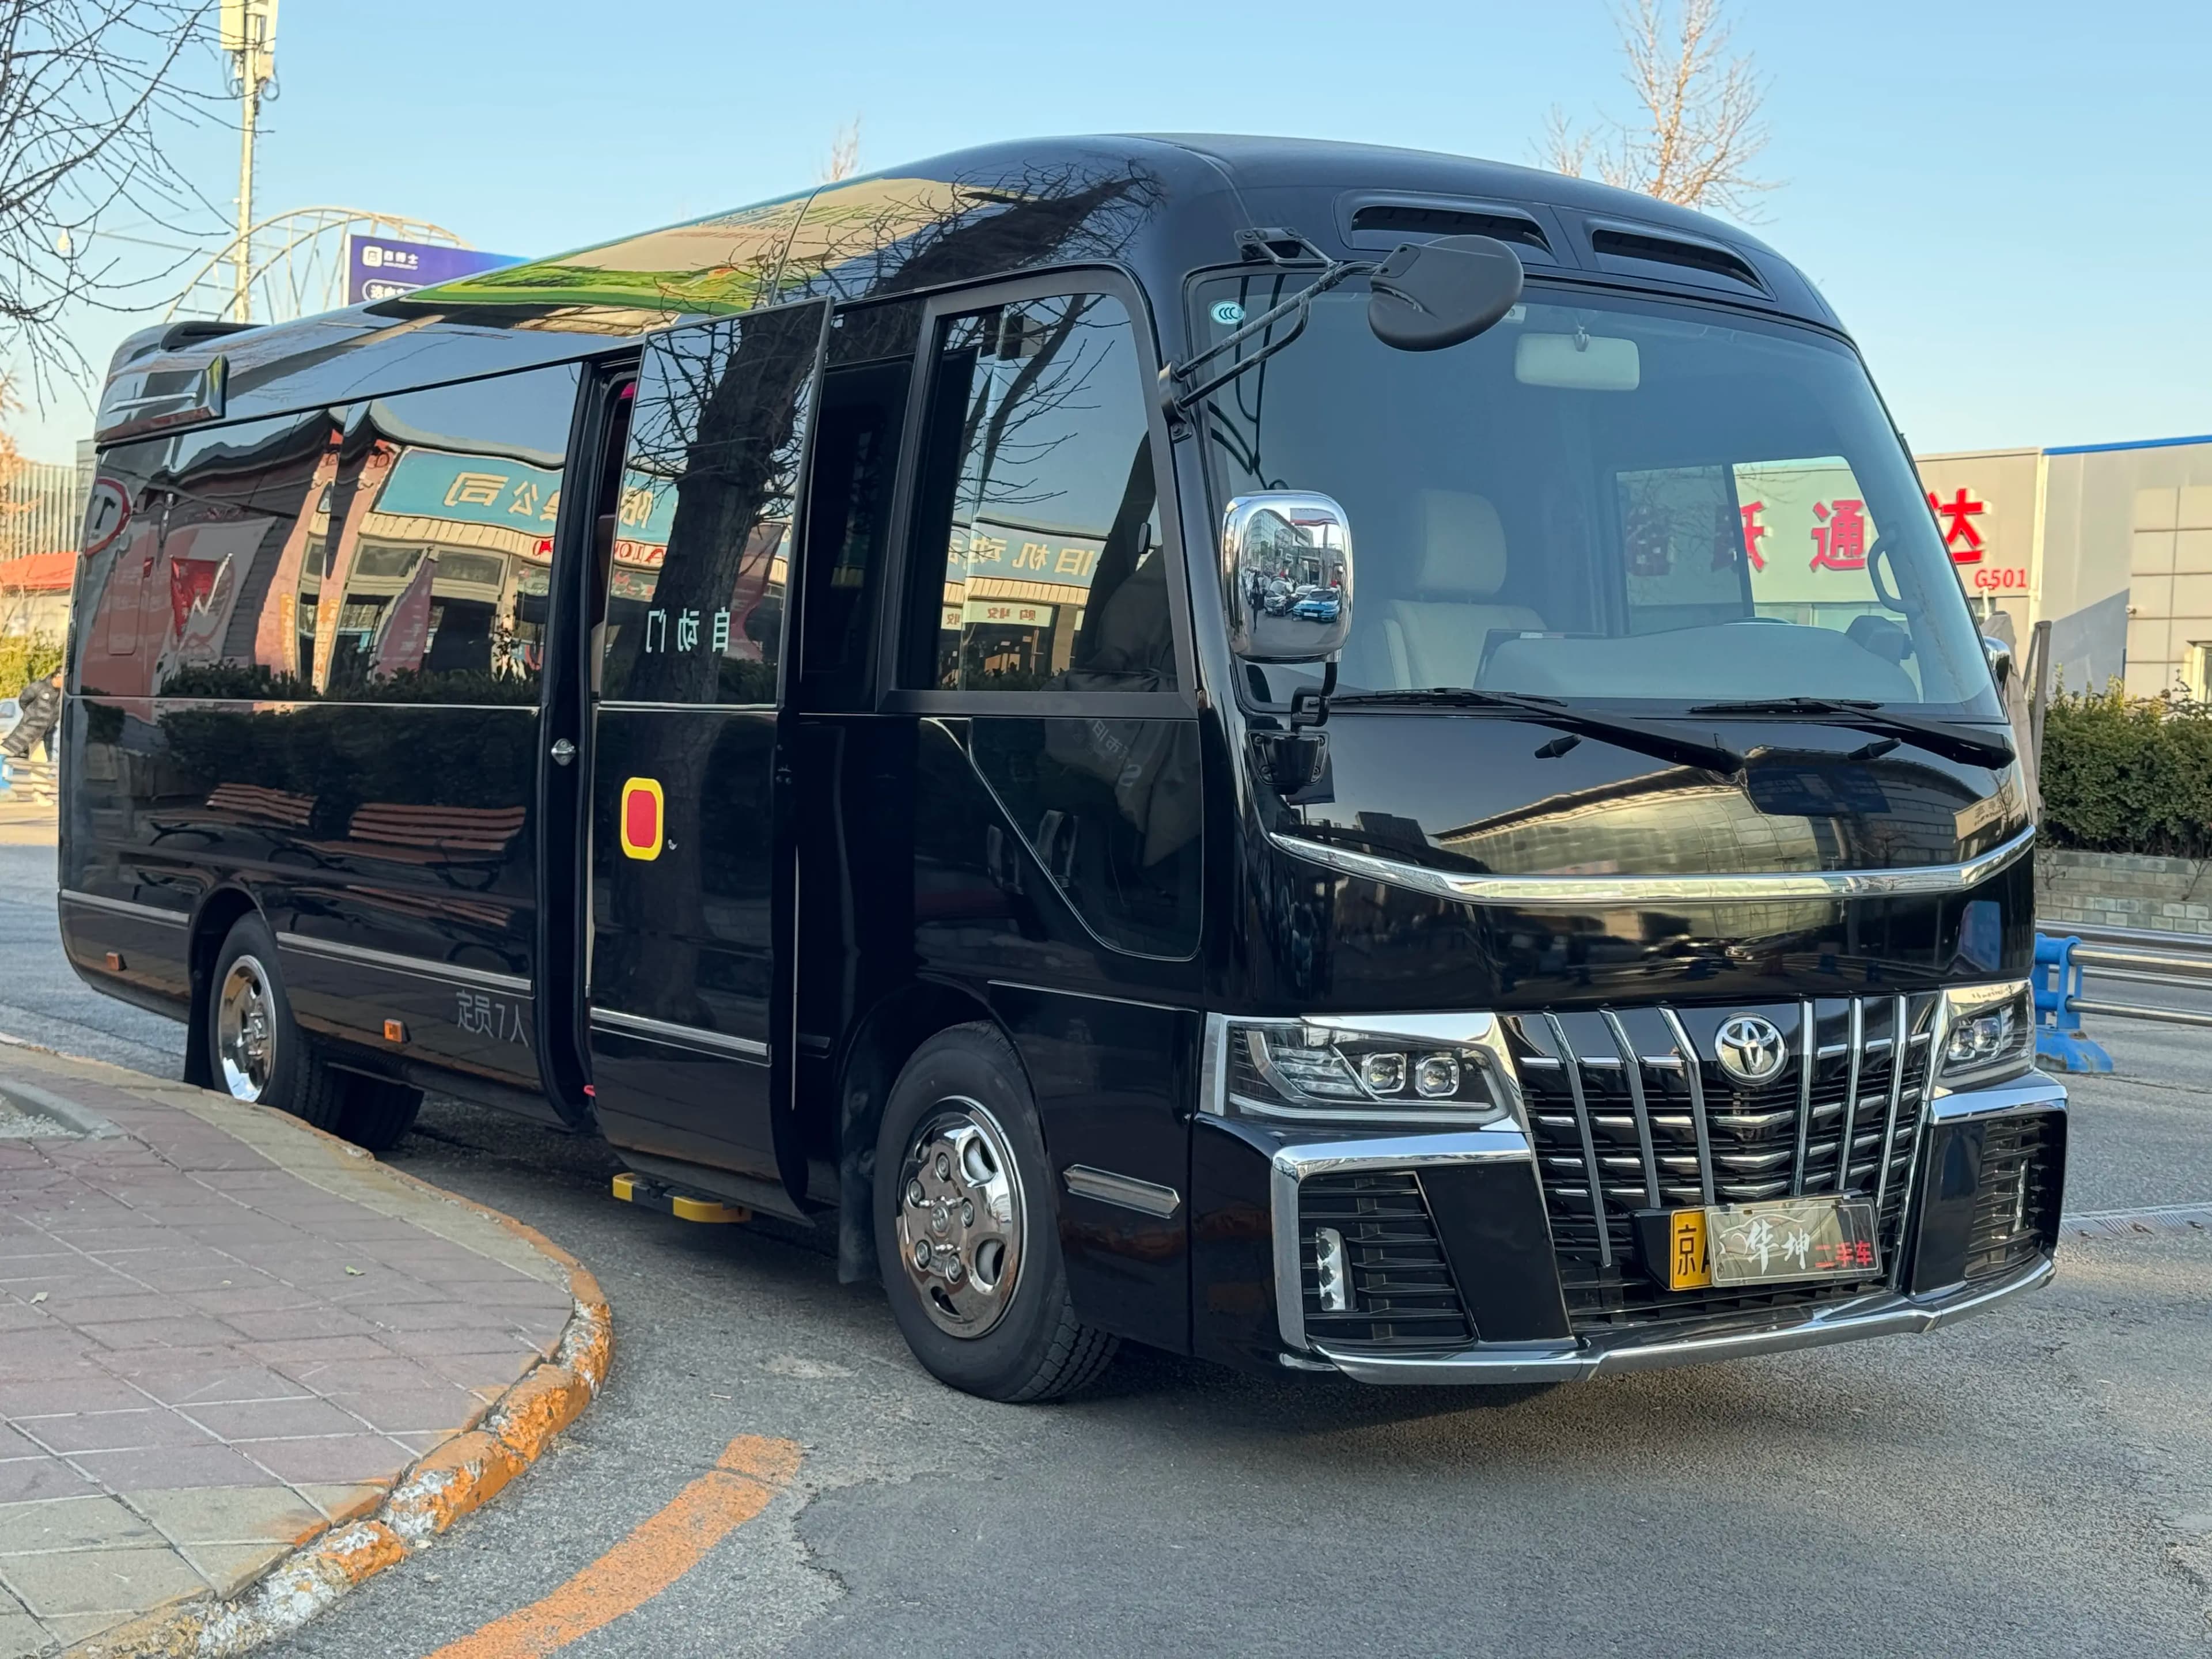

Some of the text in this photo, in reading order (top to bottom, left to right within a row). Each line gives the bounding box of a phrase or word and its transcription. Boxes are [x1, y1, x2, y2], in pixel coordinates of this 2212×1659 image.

[1975, 569, 2028, 588] G501
[456, 989, 529, 1048] 定员7人
[1815, 1240, 1872, 1267] 二手车
